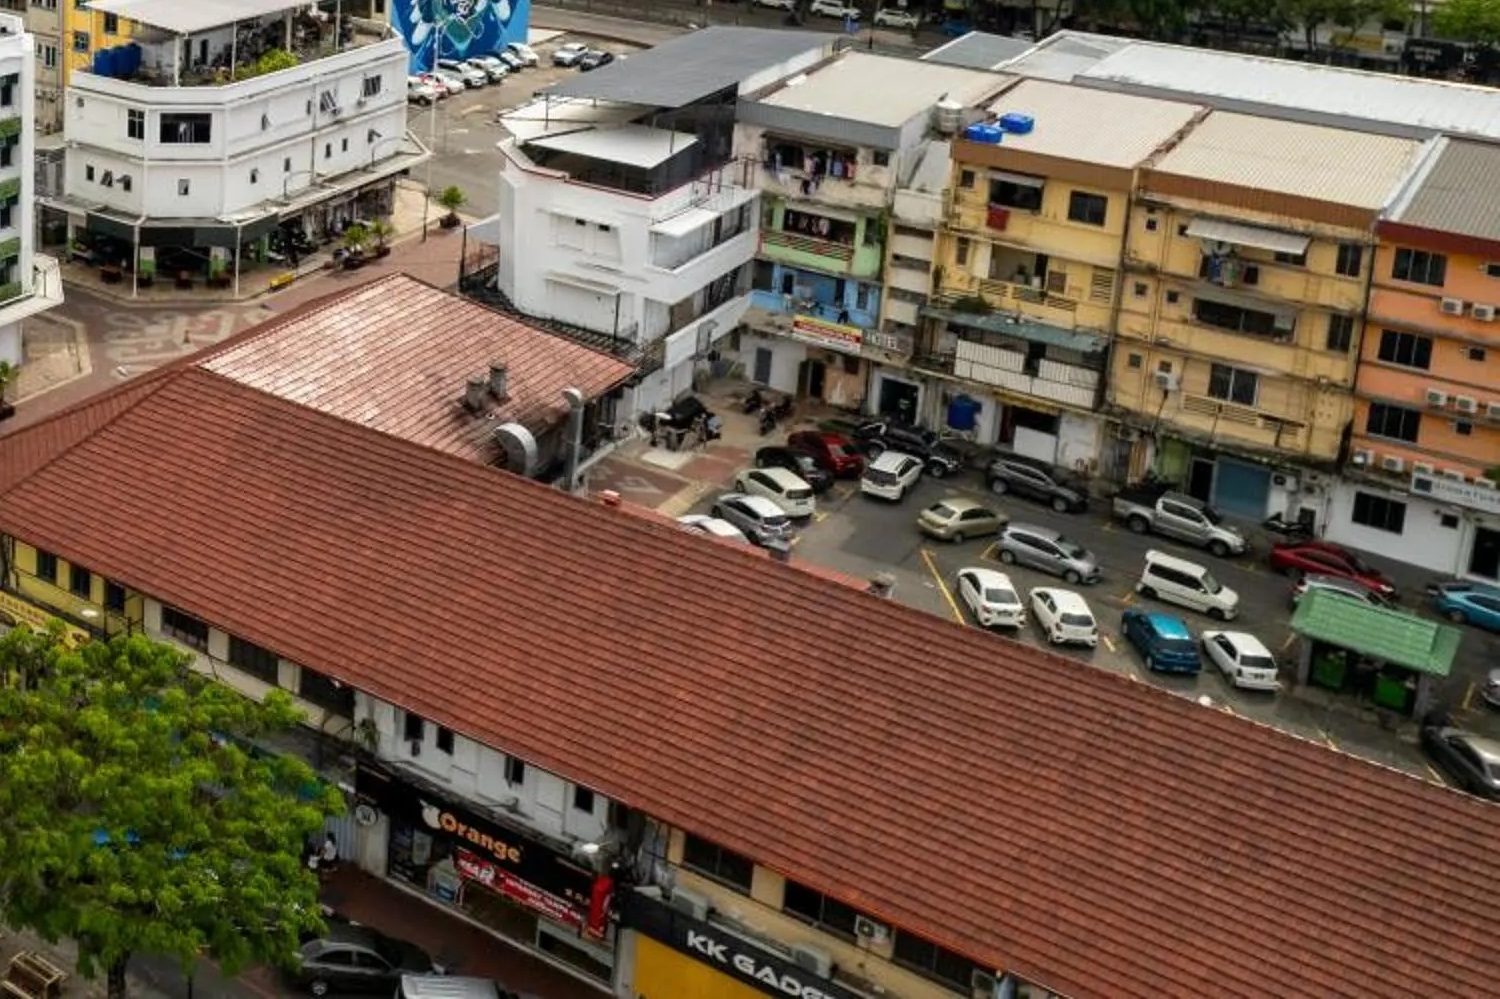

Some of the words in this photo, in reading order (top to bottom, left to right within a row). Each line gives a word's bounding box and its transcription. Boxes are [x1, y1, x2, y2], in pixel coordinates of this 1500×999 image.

[438, 812, 521, 863] Orange
[686, 929, 729, 963] KK
[732, 953, 836, 999] GADG
